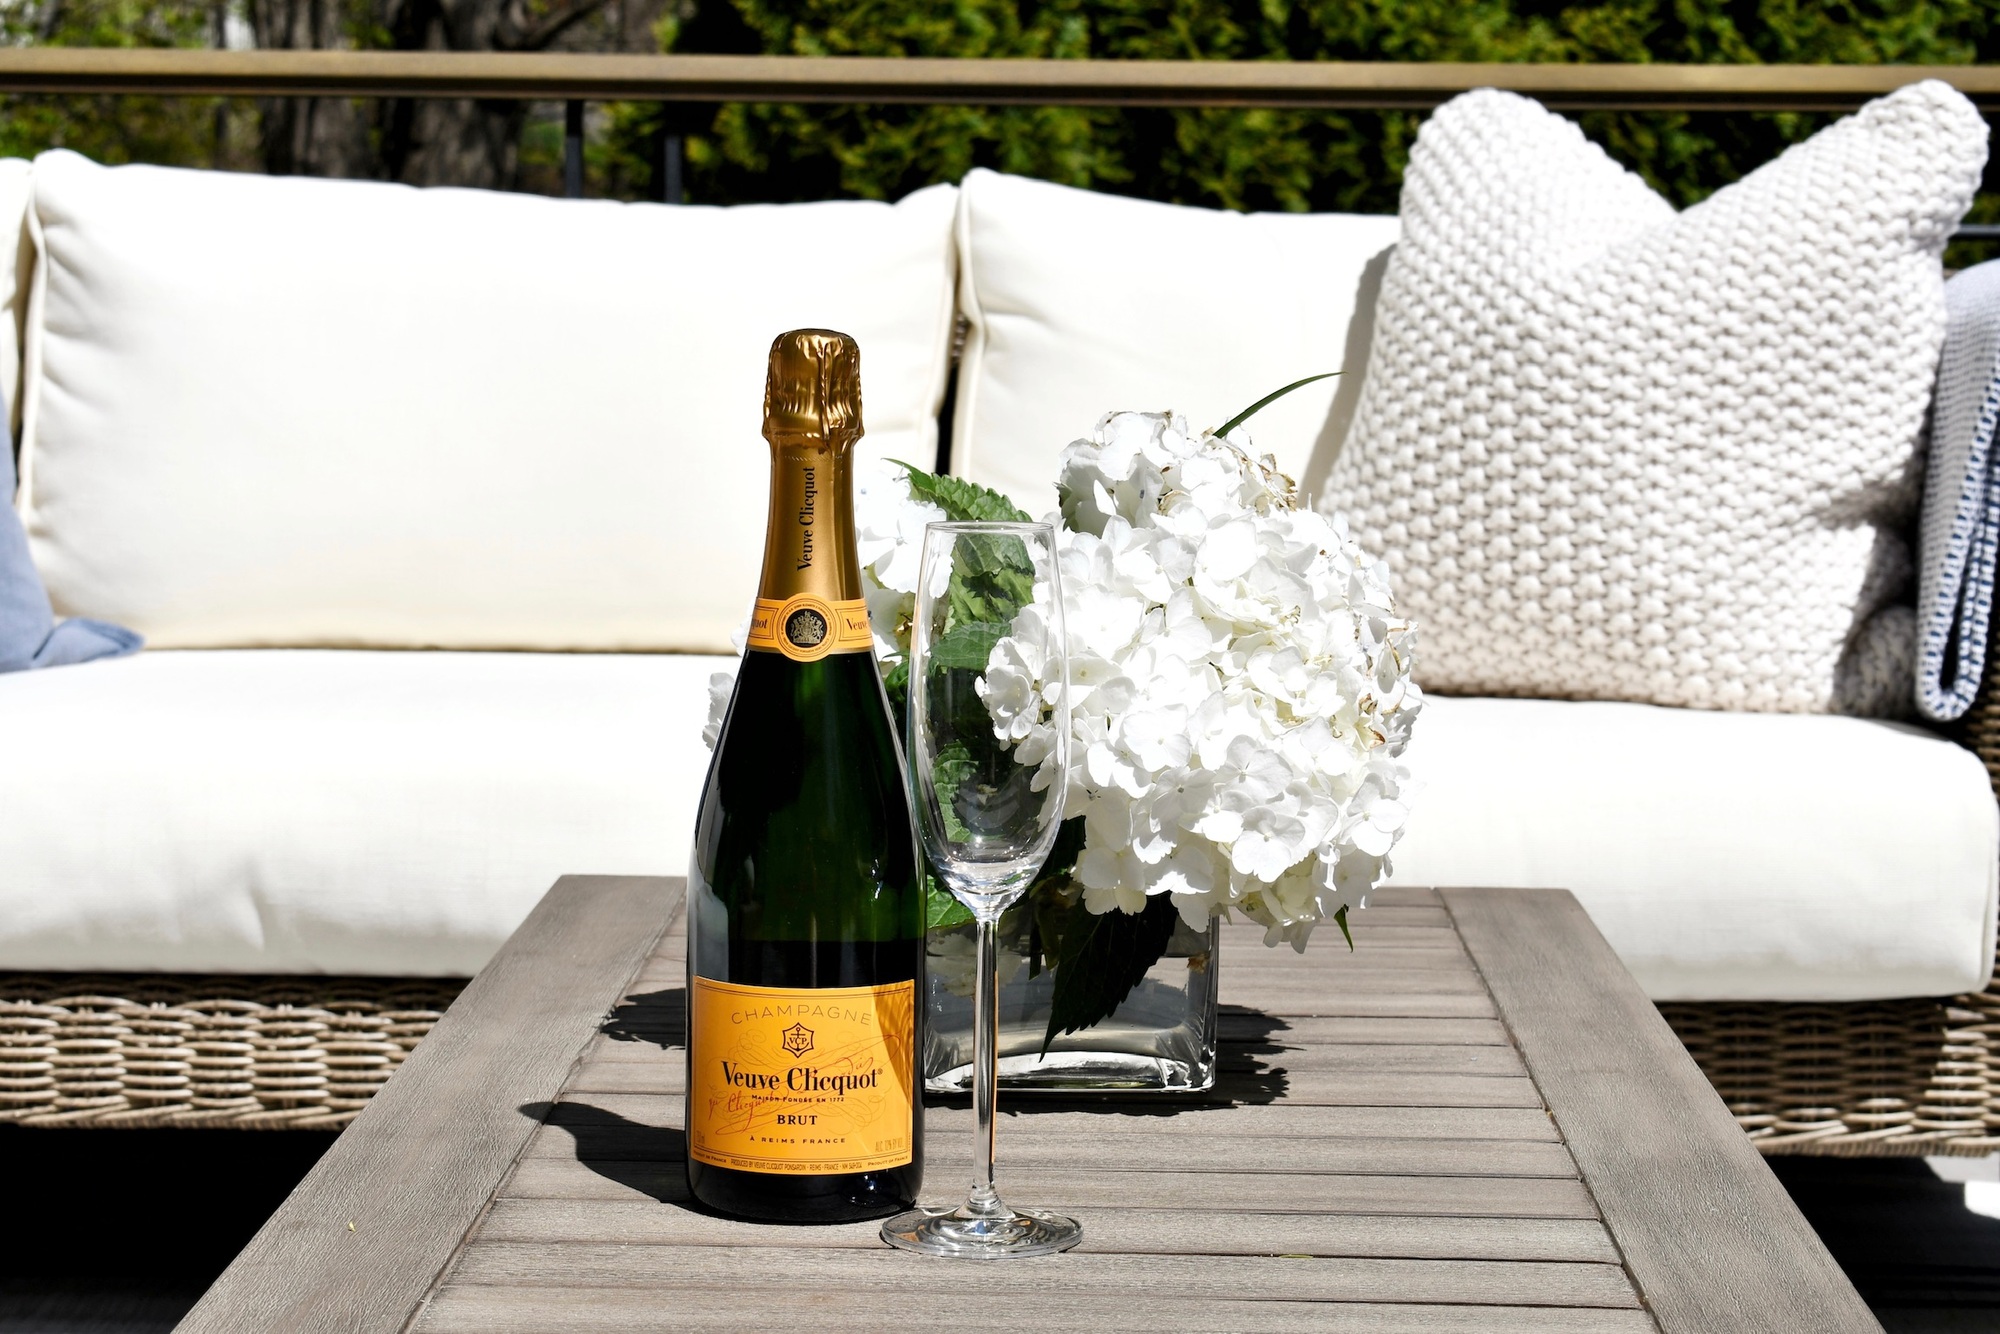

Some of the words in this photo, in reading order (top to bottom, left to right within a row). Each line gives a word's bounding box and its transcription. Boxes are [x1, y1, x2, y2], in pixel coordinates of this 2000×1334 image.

[799, 466, 818, 527] Clicquot
[797, 530, 813, 571] Veuve
[731, 1004, 872, 1026] CHAMPAGNE
[789, 1037, 808, 1046] VCP
[721, 1060, 780, 1090] Veuve
[777, 1114, 818, 1125] BRUT
